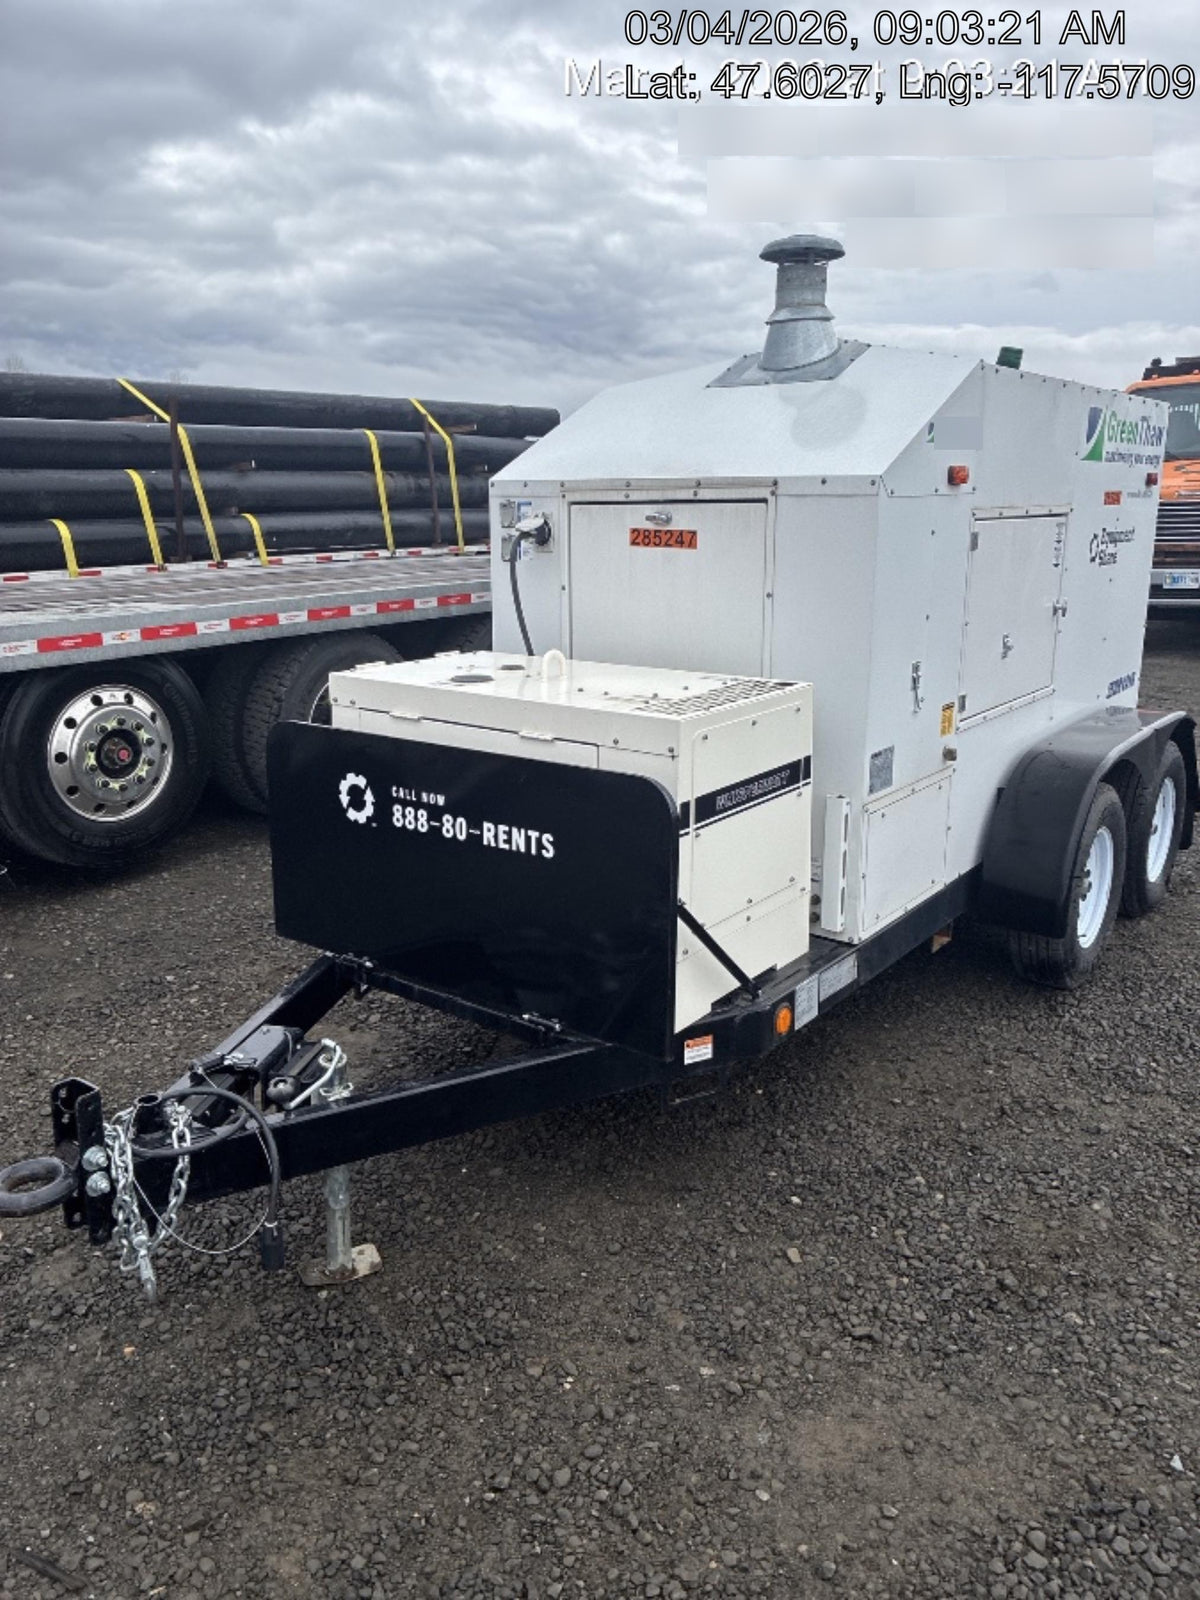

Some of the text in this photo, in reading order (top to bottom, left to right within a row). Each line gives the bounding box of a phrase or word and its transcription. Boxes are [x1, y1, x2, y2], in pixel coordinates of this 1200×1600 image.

[630, 529, 697, 549] 285247
[391, 785, 446, 806] CALL NOW
[392, 804, 555, 860] 888-80-RENTS
